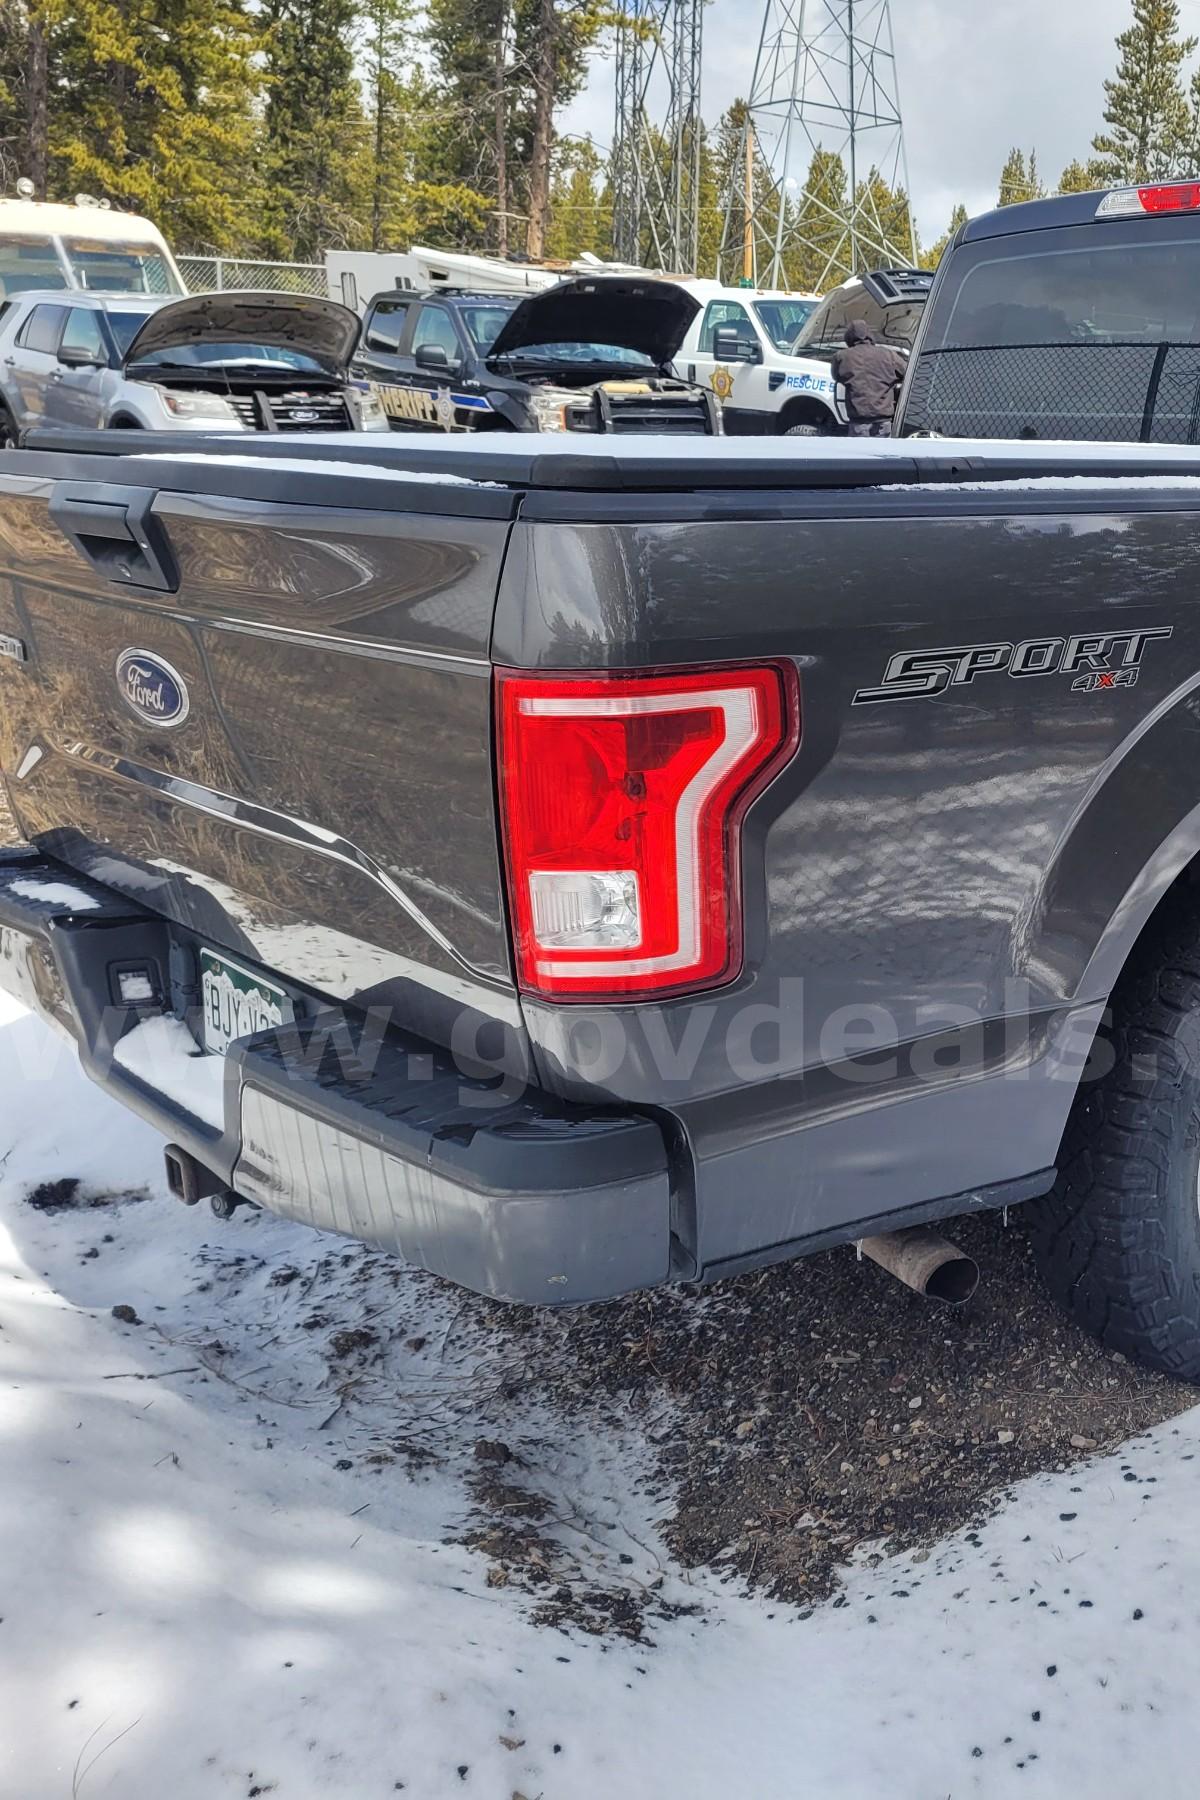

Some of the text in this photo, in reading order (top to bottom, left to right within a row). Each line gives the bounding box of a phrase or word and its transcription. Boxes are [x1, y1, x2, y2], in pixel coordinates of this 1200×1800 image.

[786, 376, 827, 392] RESCUE
[126, 664, 164, 711] Ford
[851, 625, 1174, 705] SPORT
